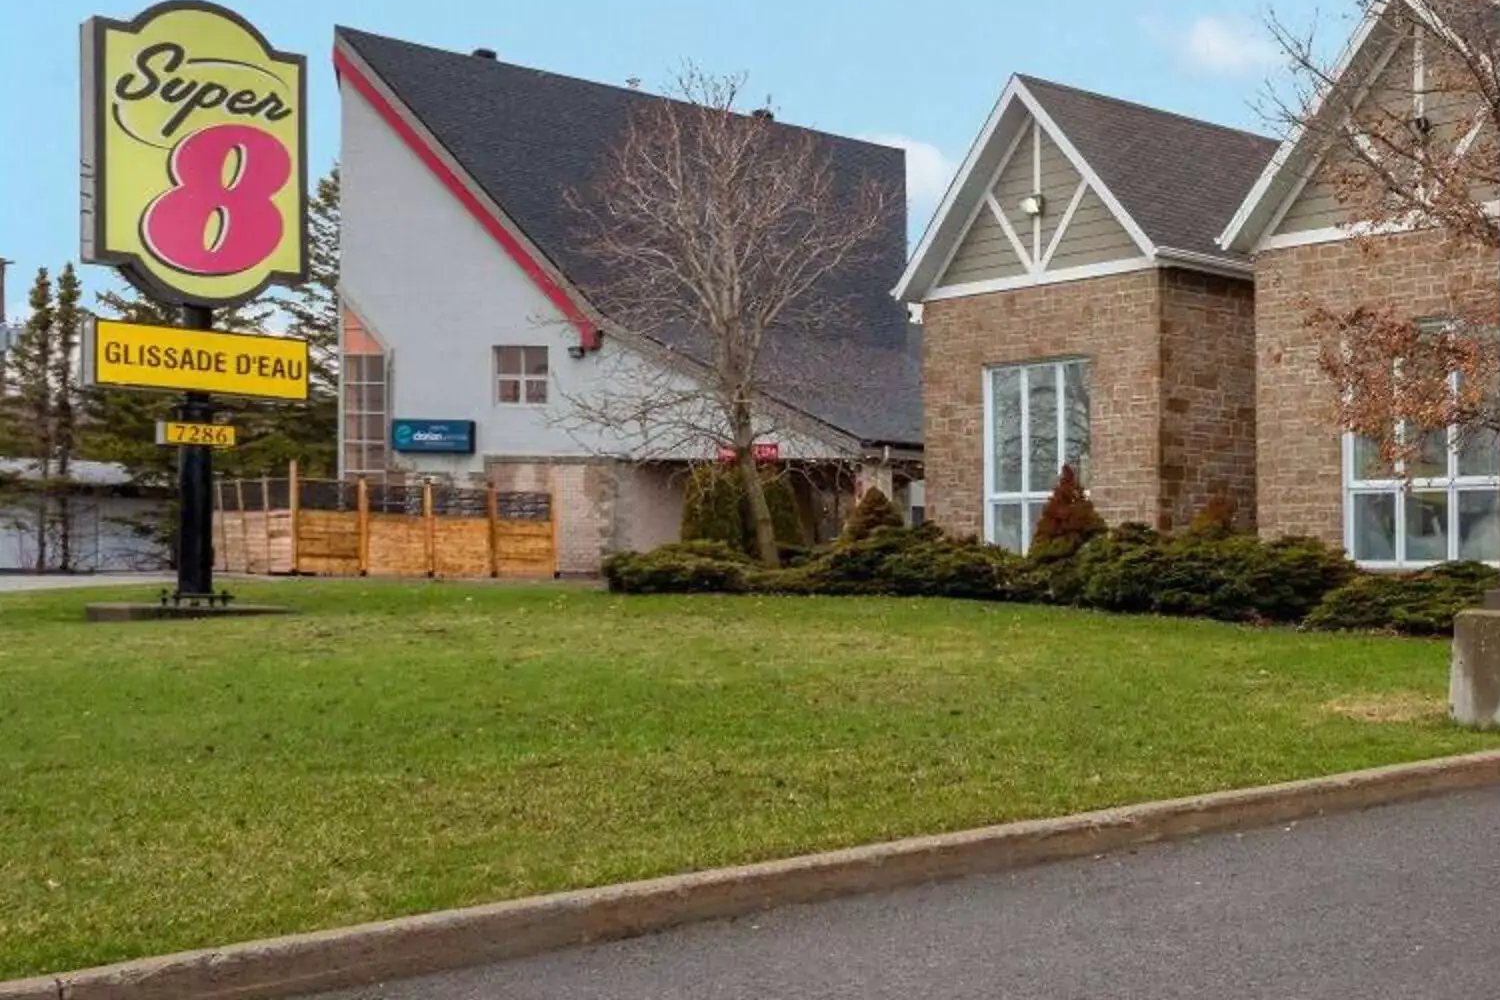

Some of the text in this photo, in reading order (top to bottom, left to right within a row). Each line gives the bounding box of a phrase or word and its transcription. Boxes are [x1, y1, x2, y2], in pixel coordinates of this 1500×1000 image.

[115, 42, 292, 138] Super
[139, 124, 292, 277] 8
[105, 341, 302, 381] GLISSADE D'EAU
[175, 425, 227, 444] 7286
